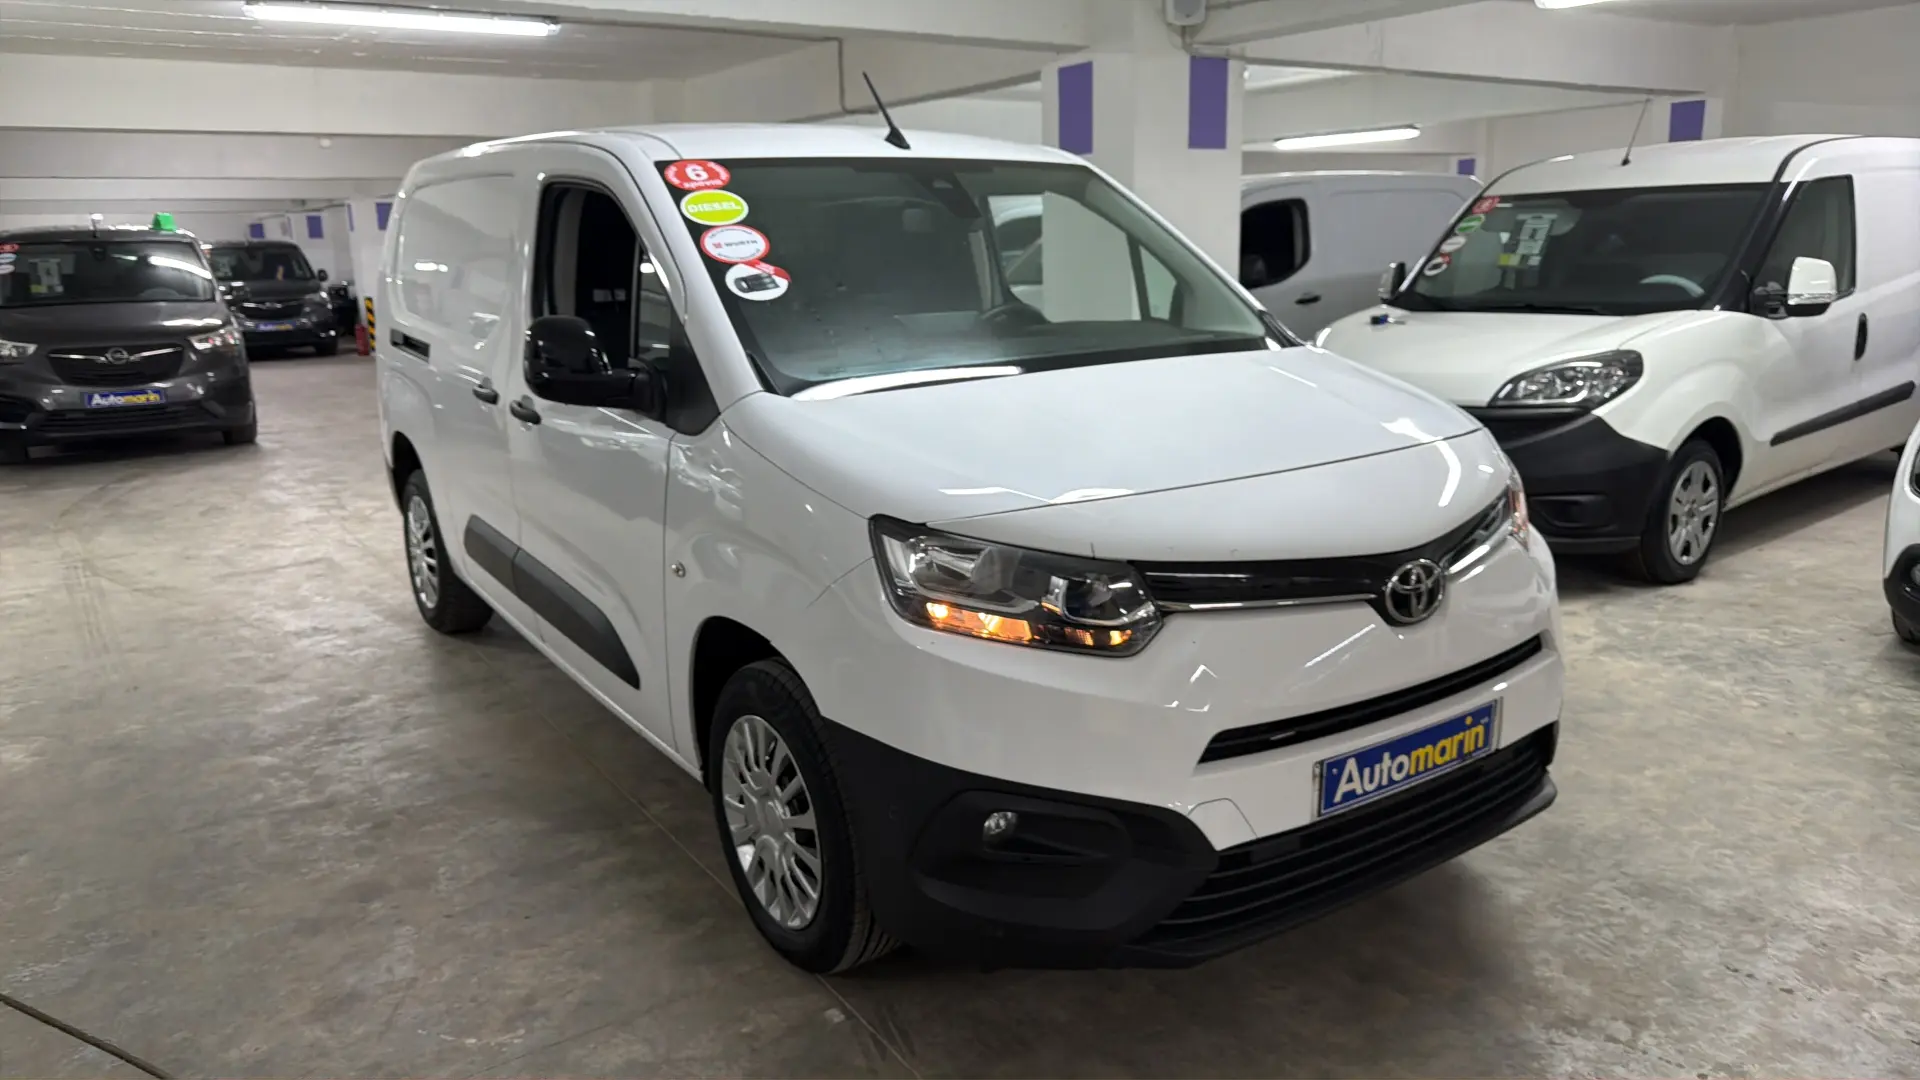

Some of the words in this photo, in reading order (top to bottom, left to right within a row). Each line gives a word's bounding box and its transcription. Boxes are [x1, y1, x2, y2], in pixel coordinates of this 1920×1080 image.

[685, 163, 709, 181] 6
[687, 201, 742, 213] DIESEL
[91, 391, 160, 406] Automarin
[1333, 715, 1486, 803] Automarin
